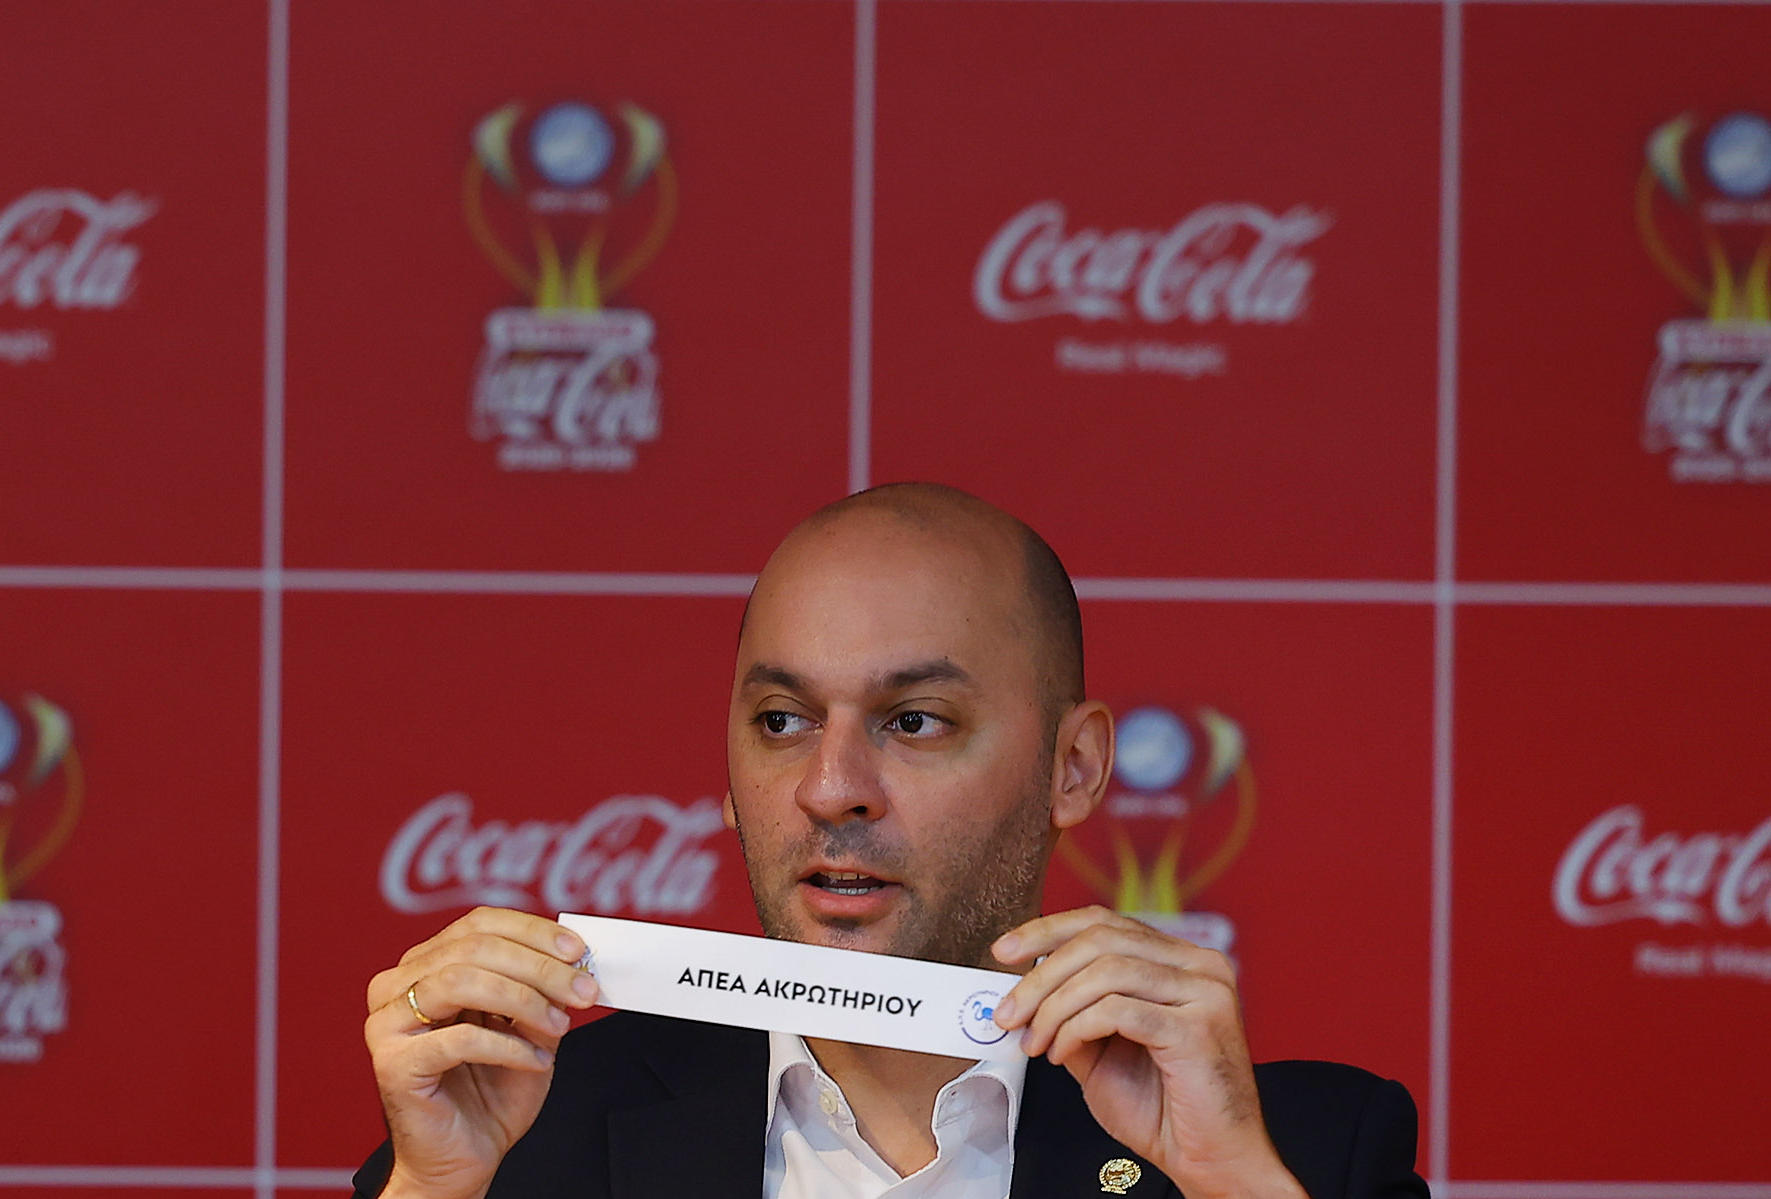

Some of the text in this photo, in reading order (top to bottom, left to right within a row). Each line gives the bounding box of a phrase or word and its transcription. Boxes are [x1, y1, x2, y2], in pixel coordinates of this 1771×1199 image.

[974, 201, 1333, 323] Coca-Cola
[382, 792, 724, 914] Coca-Cola
[678, 967, 746, 993] ΑΠΕΑ
[754, 978, 923, 1017] ΑΚΡΩΤΗΡΙΟΥ
